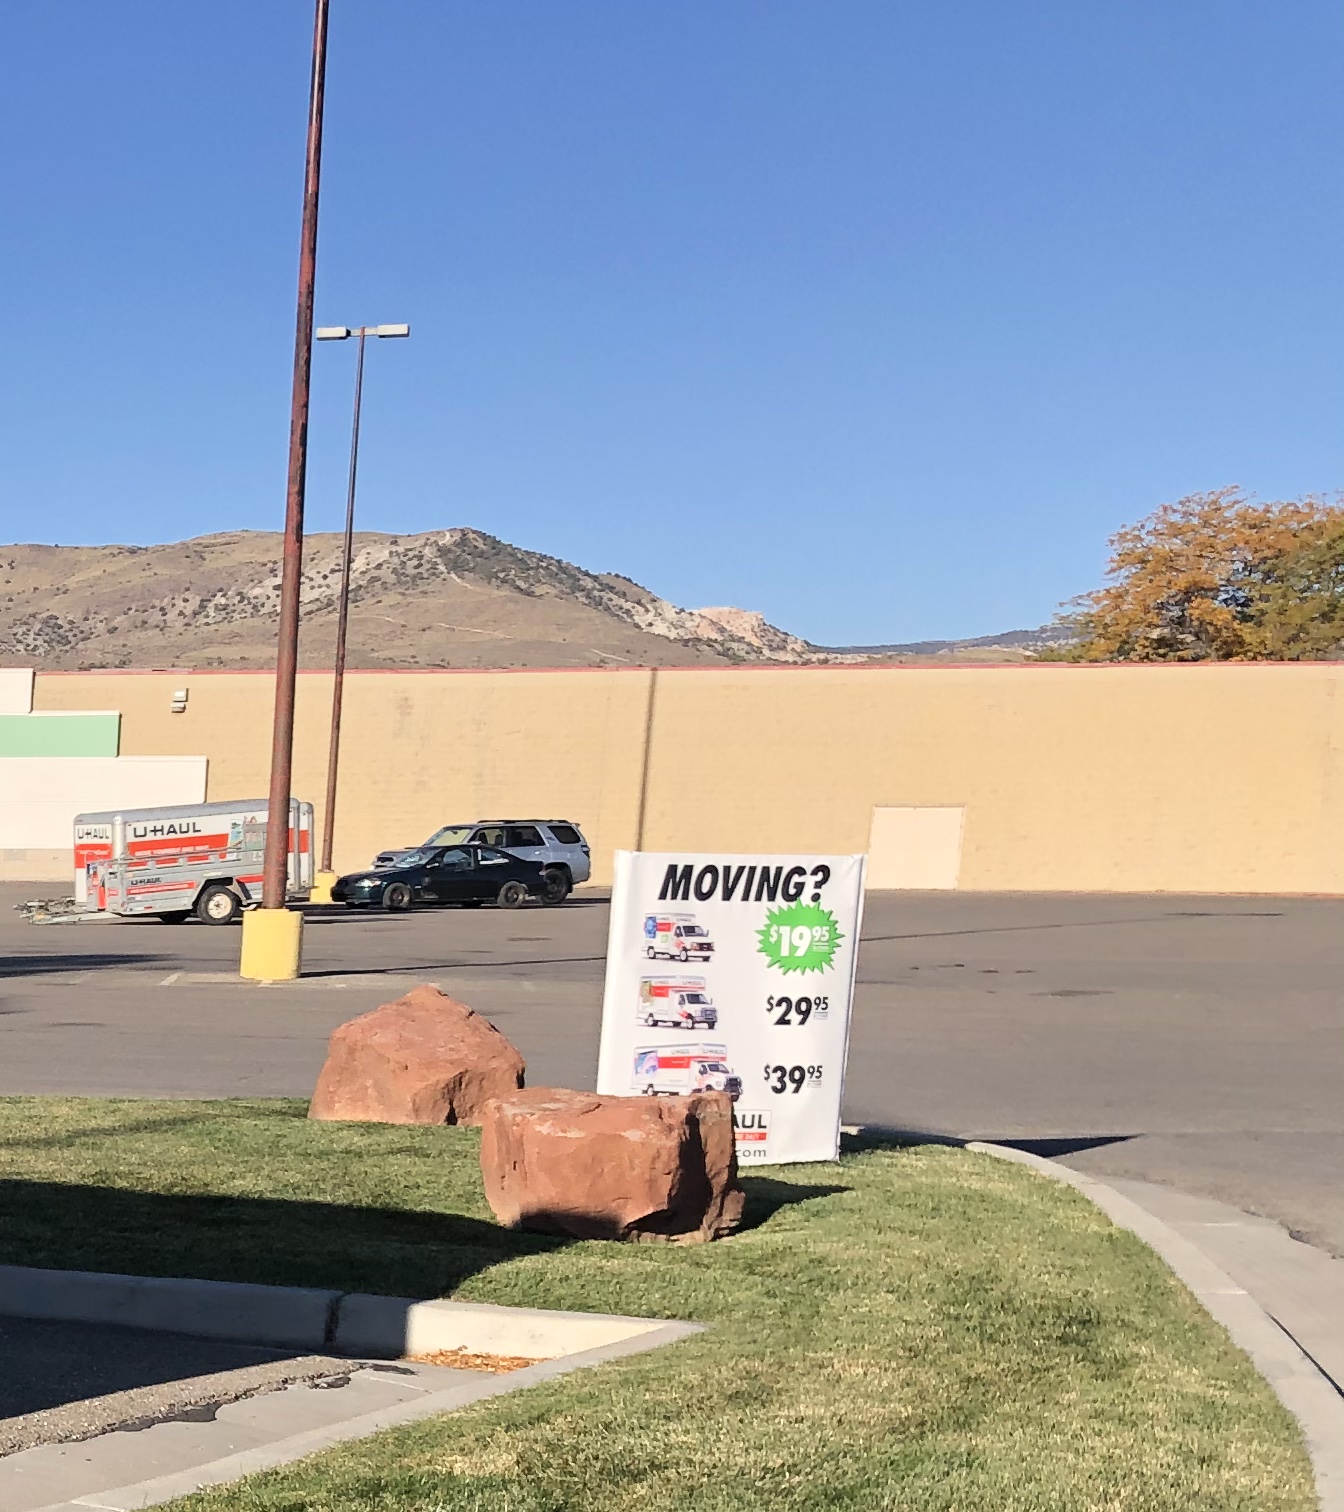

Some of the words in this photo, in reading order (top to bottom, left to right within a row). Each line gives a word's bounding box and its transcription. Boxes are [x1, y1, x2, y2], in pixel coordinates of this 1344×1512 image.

[77, 826, 110, 840] U-HAUL
[133, 822, 202, 838] U-HAUL
[659, 864, 830, 902] MOVING?
